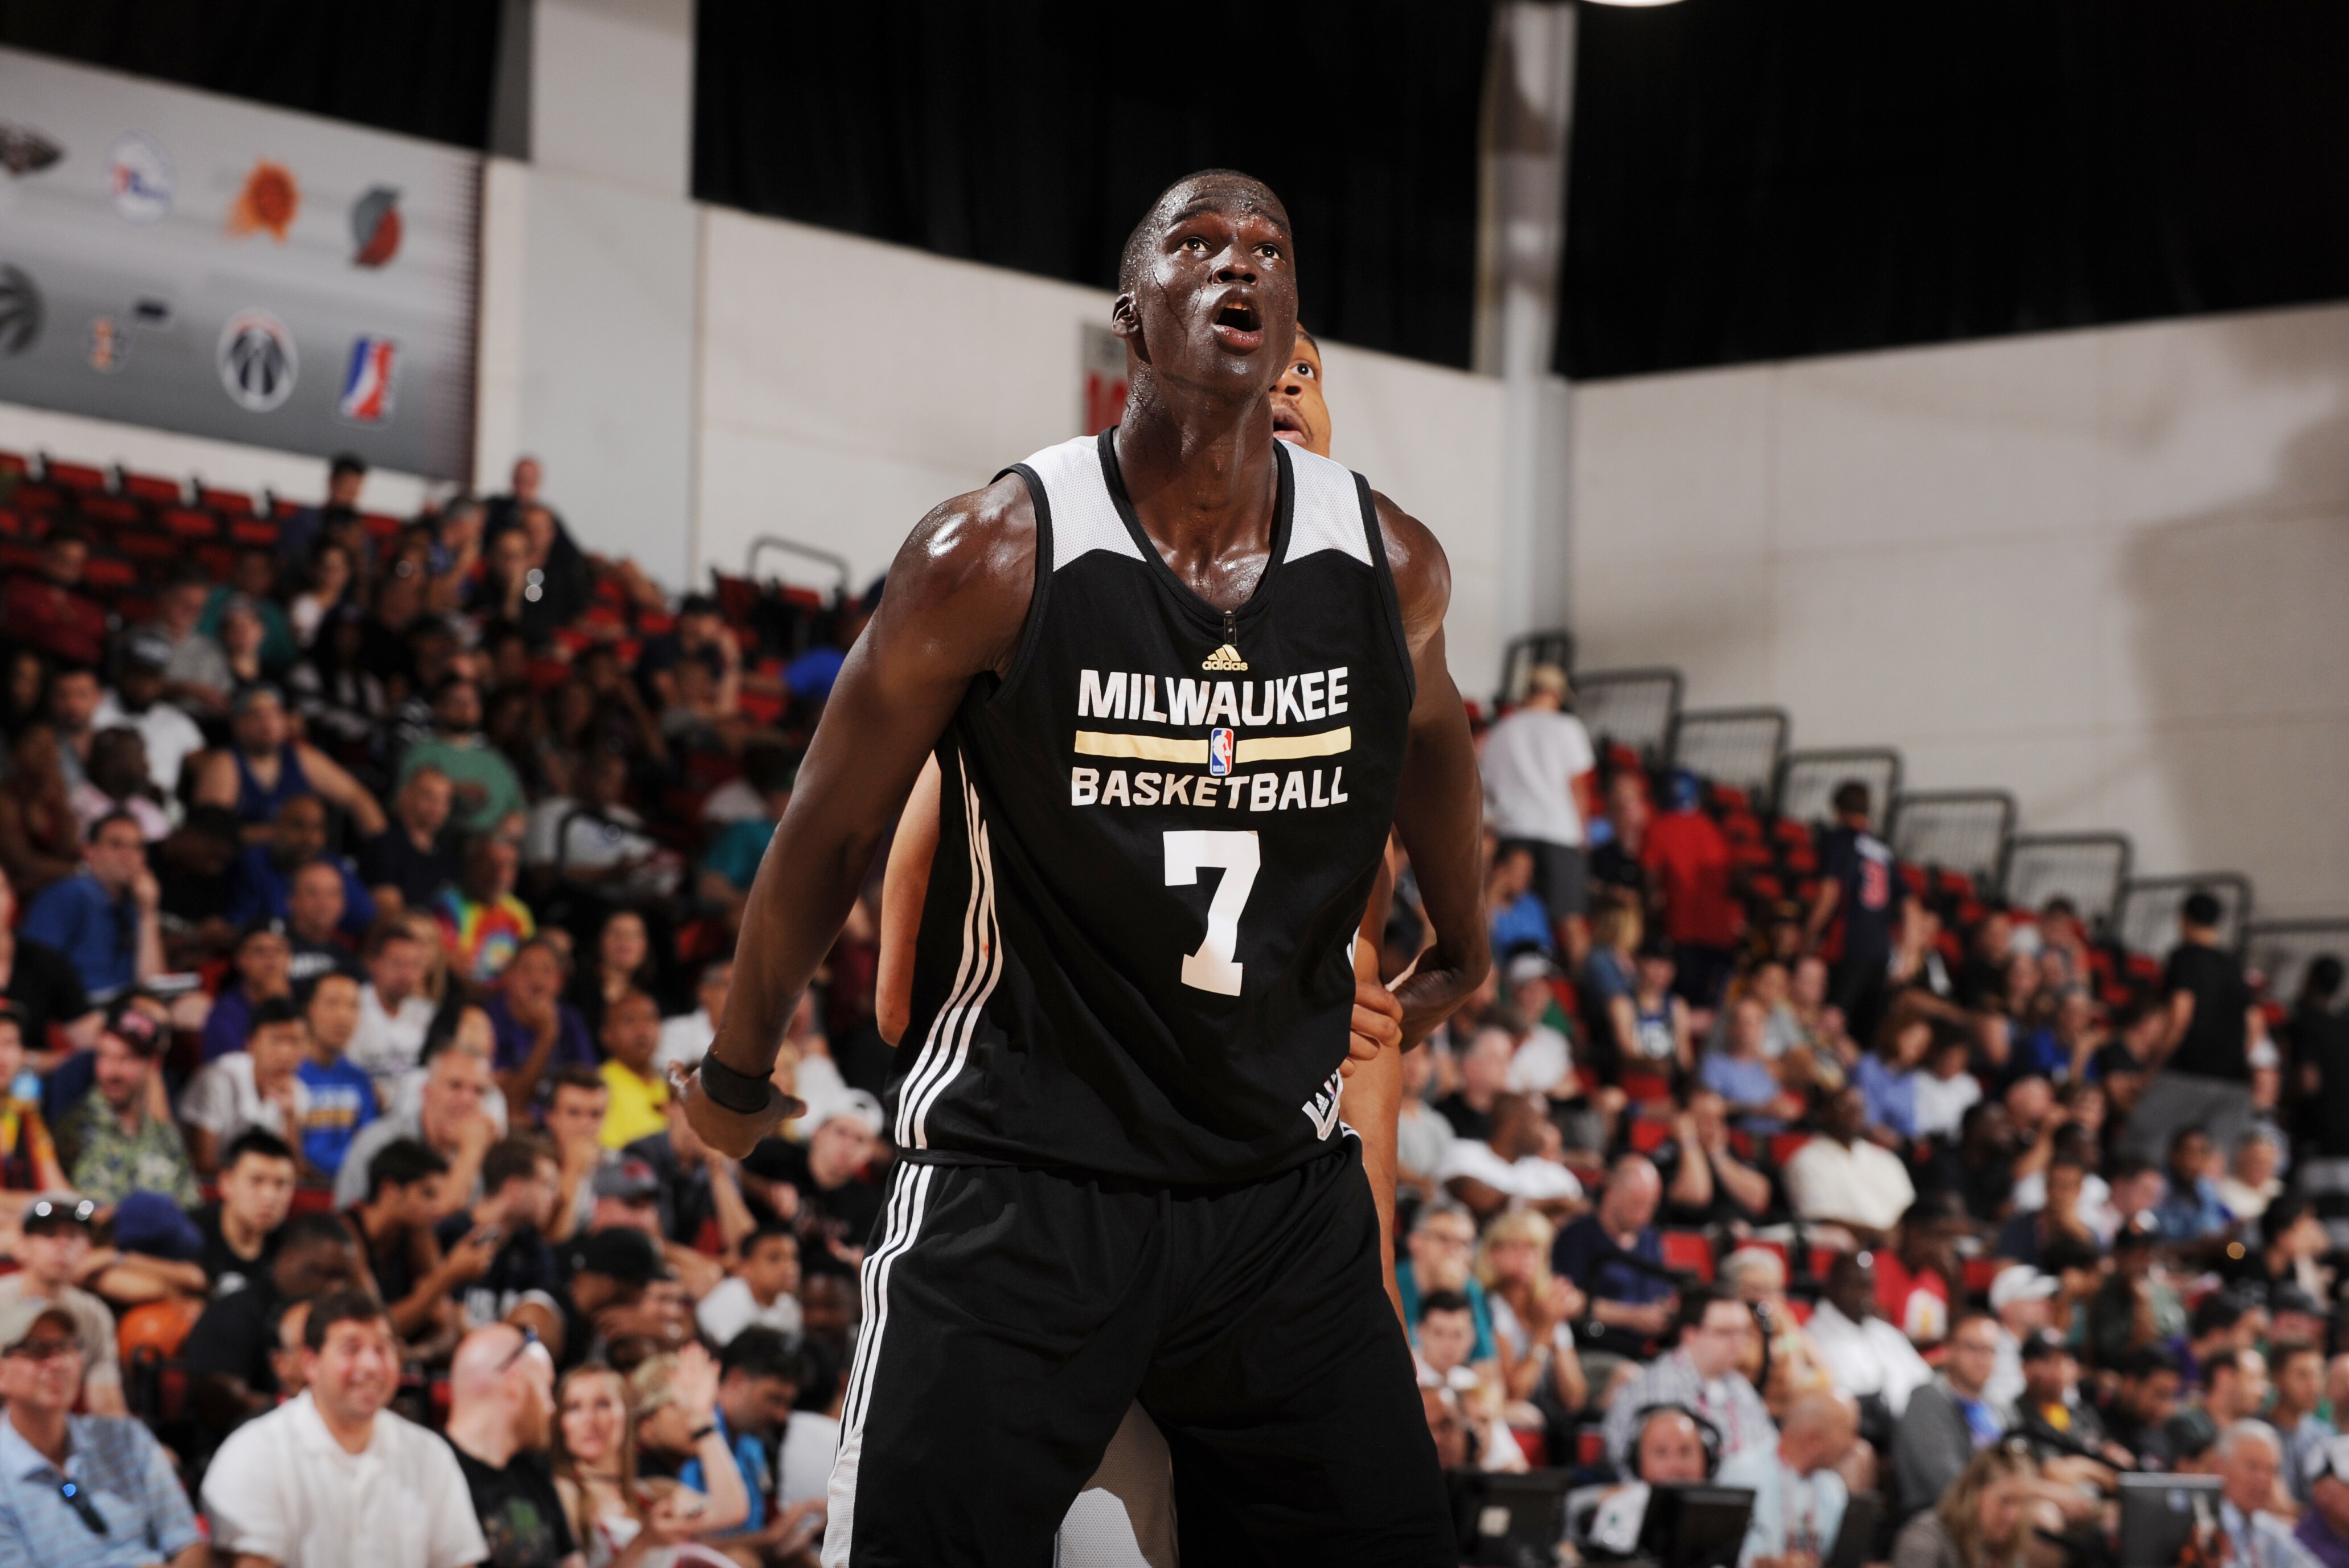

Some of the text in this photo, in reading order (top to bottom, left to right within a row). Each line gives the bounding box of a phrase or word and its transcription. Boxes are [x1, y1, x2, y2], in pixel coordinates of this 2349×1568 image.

[1202, 658, 1248, 671] adidas
[1077, 666, 1348, 726] MILWAUKEE
[1071, 766, 1348, 812] BASKETBALL
[1163, 830, 1261, 997] 7
